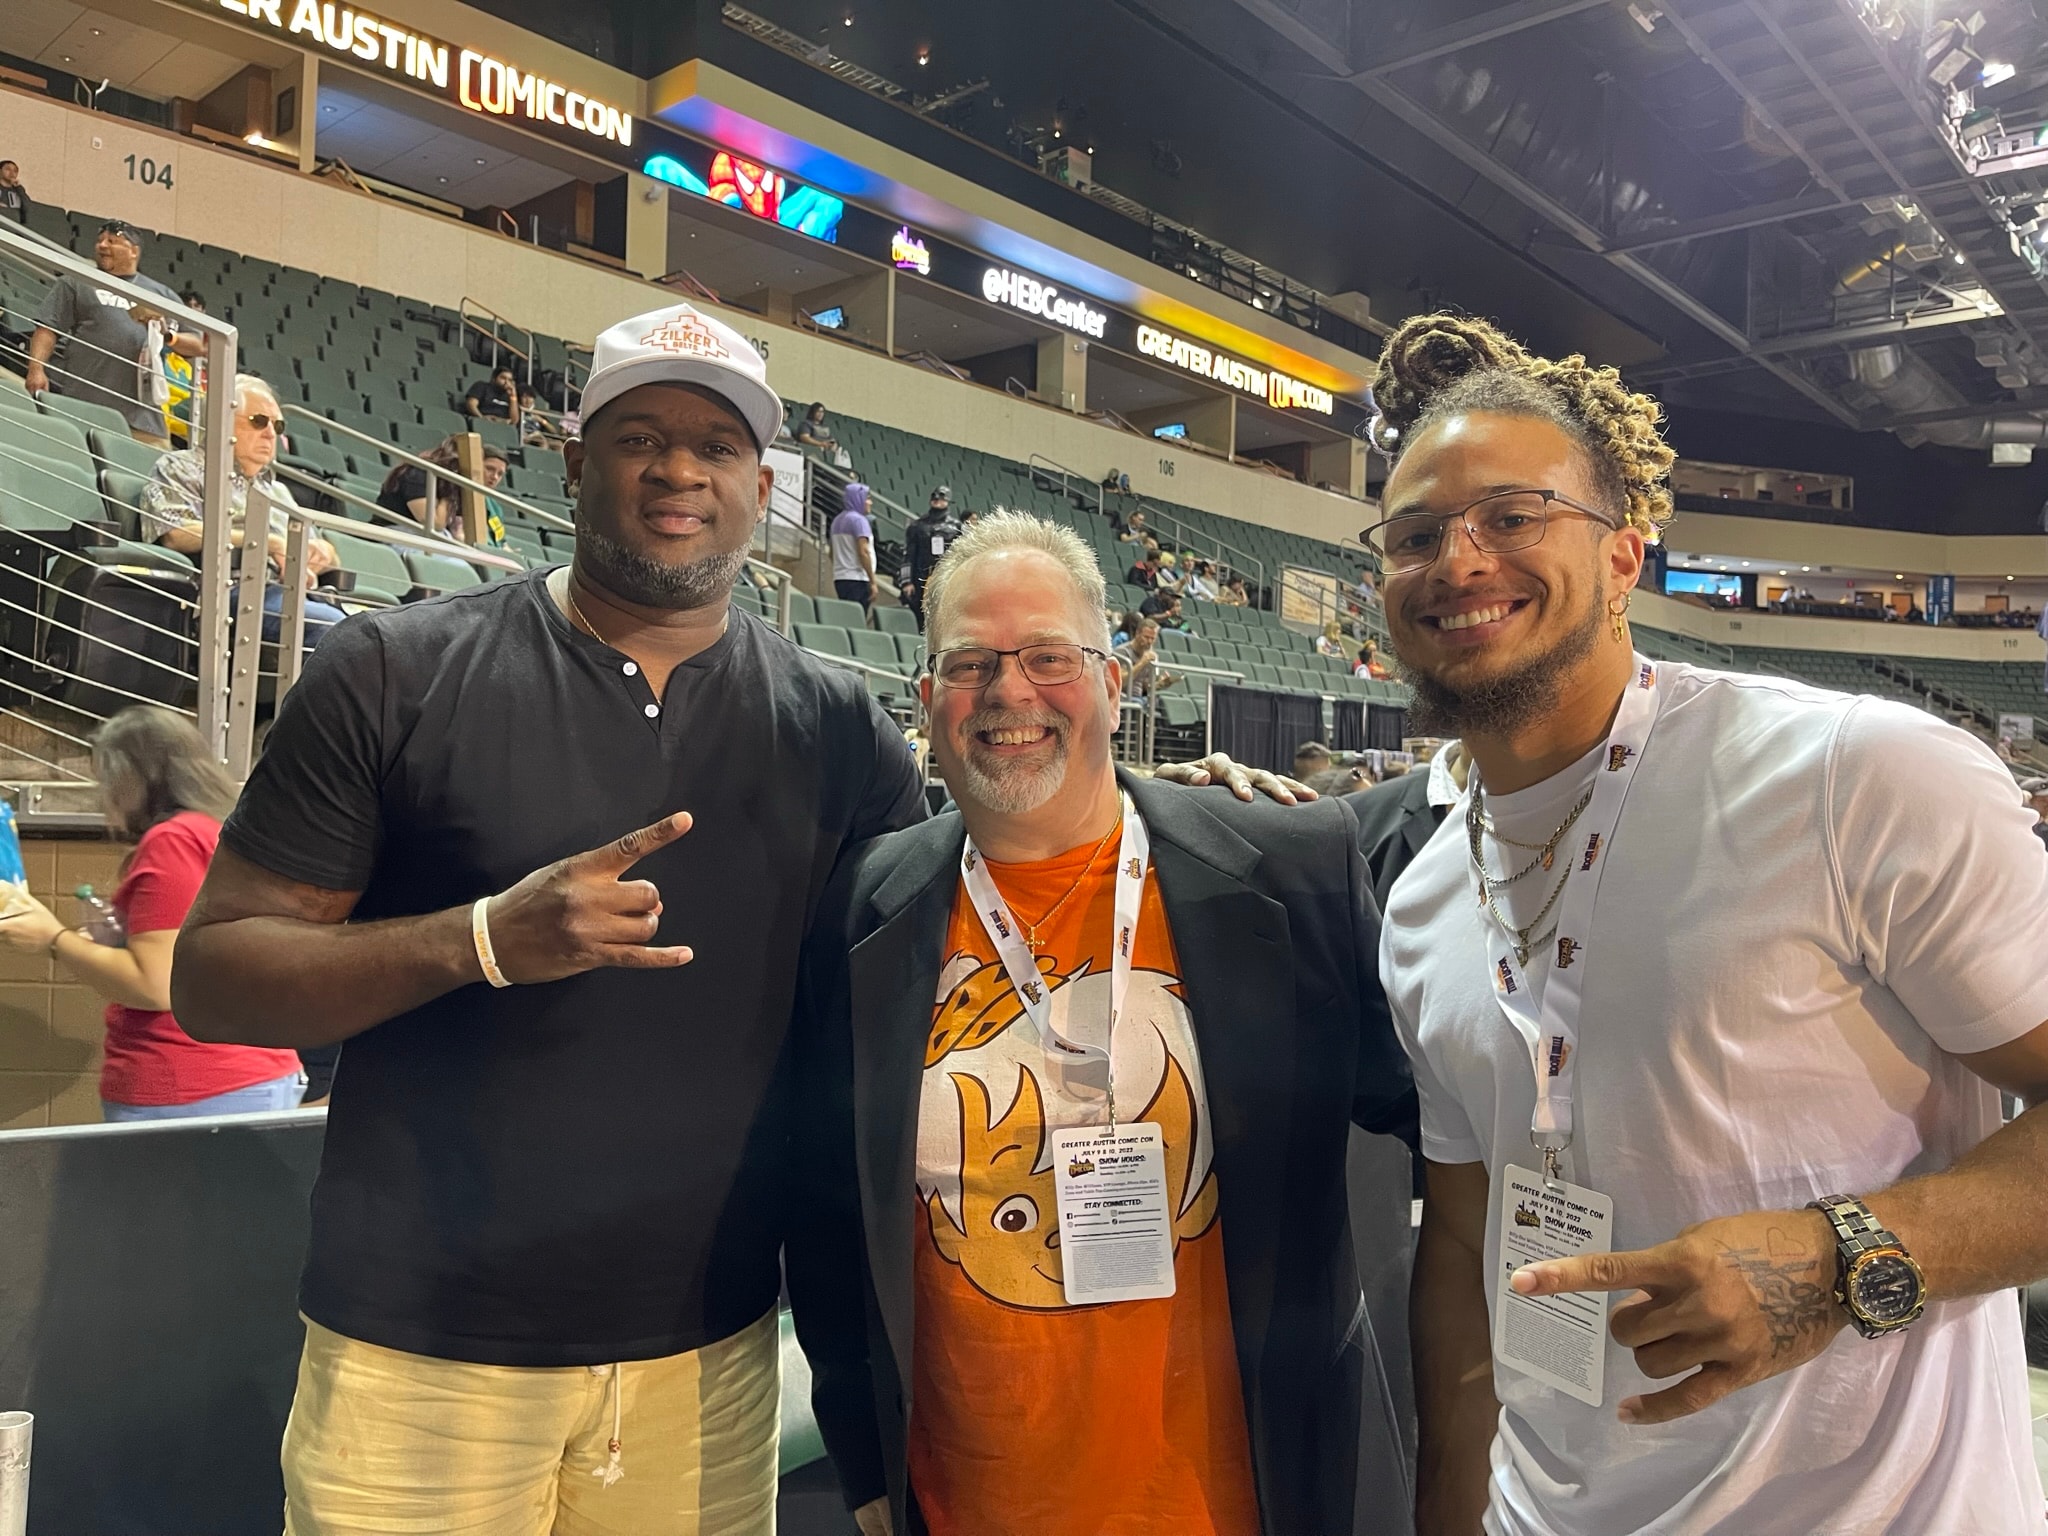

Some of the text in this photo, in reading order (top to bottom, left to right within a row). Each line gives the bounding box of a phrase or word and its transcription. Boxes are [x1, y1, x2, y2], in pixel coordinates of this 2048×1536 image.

[289, 0, 449, 88] AUSTIN
[459, 49, 632, 147] COMICCON
[124, 154, 174, 190] 104
[982, 268, 1108, 338] @HEBCenter
[660, 331, 711, 349] ZILKER
[672, 341, 699, 351] BELTS
[1137, 325, 1213, 378] GREATER
[1212, 355, 1268, 398] AUSTIN
[1158, 459, 1175, 476] 106
[1061, 1139, 1091, 1149] GREATER
[1099, 1155, 1146, 1165] SHOW HOURS:
[1084, 1199, 1143, 1209] STAY CONNECTED:
[1511, 1182, 1604, 1220] GREATER AUSTIN COMIC CON
[1529, 1200, 1543, 1209] JULY
[1544, 1216, 1566, 1229] SHOW
[1566, 1223, 1593, 1239] HOURS:
